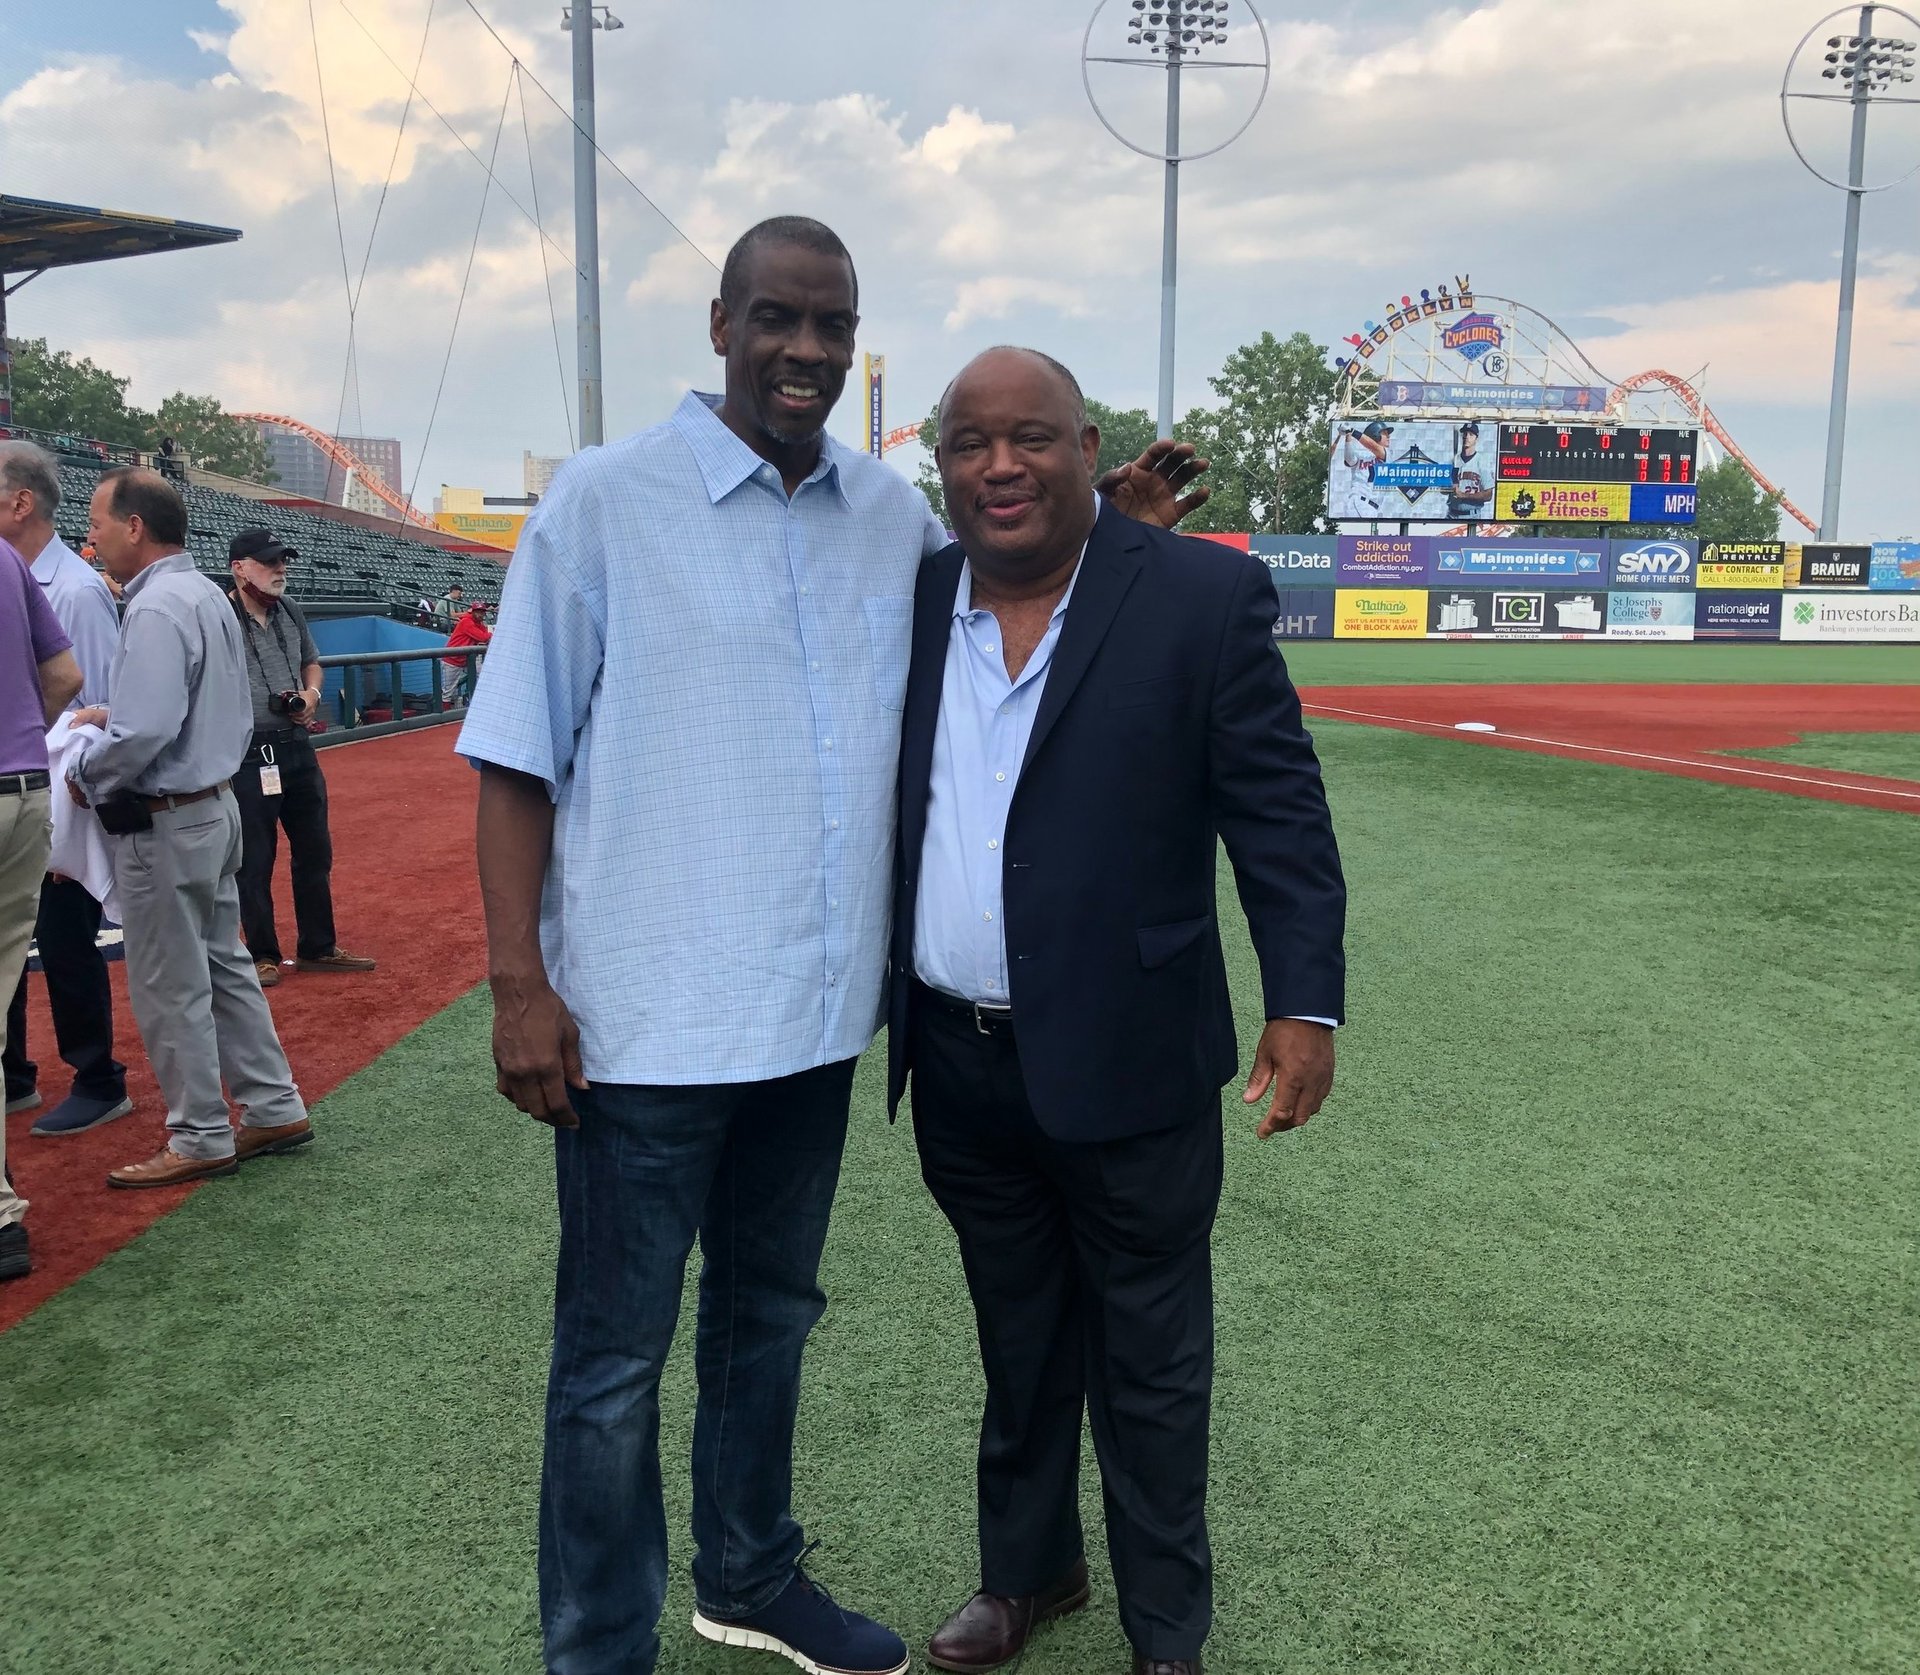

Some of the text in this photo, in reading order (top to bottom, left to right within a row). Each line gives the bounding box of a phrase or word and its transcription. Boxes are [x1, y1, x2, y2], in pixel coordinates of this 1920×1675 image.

[1445, 327, 1499, 347] CYCLONES
[1451, 387, 1534, 400] Maimonides
[1508, 426, 1530, 434] AT BAT
[1556, 427, 1572, 435] BALL
[1595, 428, 1618, 436] STRIKE
[1639, 429, 1652, 437] OUT
[1678, 430, 1690, 438] H/E
[1560, 433, 1569, 448] 0
[1601, 435, 1610, 449] 0
[1641, 436, 1650, 450] 0
[1640, 460, 1648, 470] 0
[1664, 460, 1671, 471] 0
[1682, 460, 1689, 471] 0
[1377, 465, 1450, 478] Maimonides
[1640, 471, 1647, 482] 0
[1663, 471, 1671, 482] 0
[1681, 471, 1688, 483] 0
[1540, 487, 1598, 504] planet
[1547, 502, 1609, 518] fitness
[1664, 494, 1696, 514] MPH
[452, 514, 513, 530] Nathan's
[1356, 540, 1412, 552] Strike out
[1719, 544, 1781, 554] DURANTE
[1874, 547, 1898, 556] NOW
[1288, 550, 1331, 569] Data
[1354, 551, 1412, 563] addiction.
[1471, 552, 1566, 565] Maimonides
[1617, 552, 1679, 573] SNY
[1342, 563, 1424, 573] CombatAddiction.ny.gov
[1702, 565, 1714, 573] WE
[1810, 563, 1860, 576] BRAVEN
[1615, 574, 1691, 584] HOME OF THE METS
[1723, 576, 1777, 584] 1-800-DURANTE
[1356, 599, 1406, 611] Nathan's
[1613, 597, 1624, 606] St
[1612, 607, 1650, 621] College
[1708, 602, 1770, 617] nationalgrid
[1820, 625, 1847, 634] Banking
[1848, 625, 1855, 633] in
[1856, 626, 1872, 634] your
[1873, 625, 1887, 633] best
